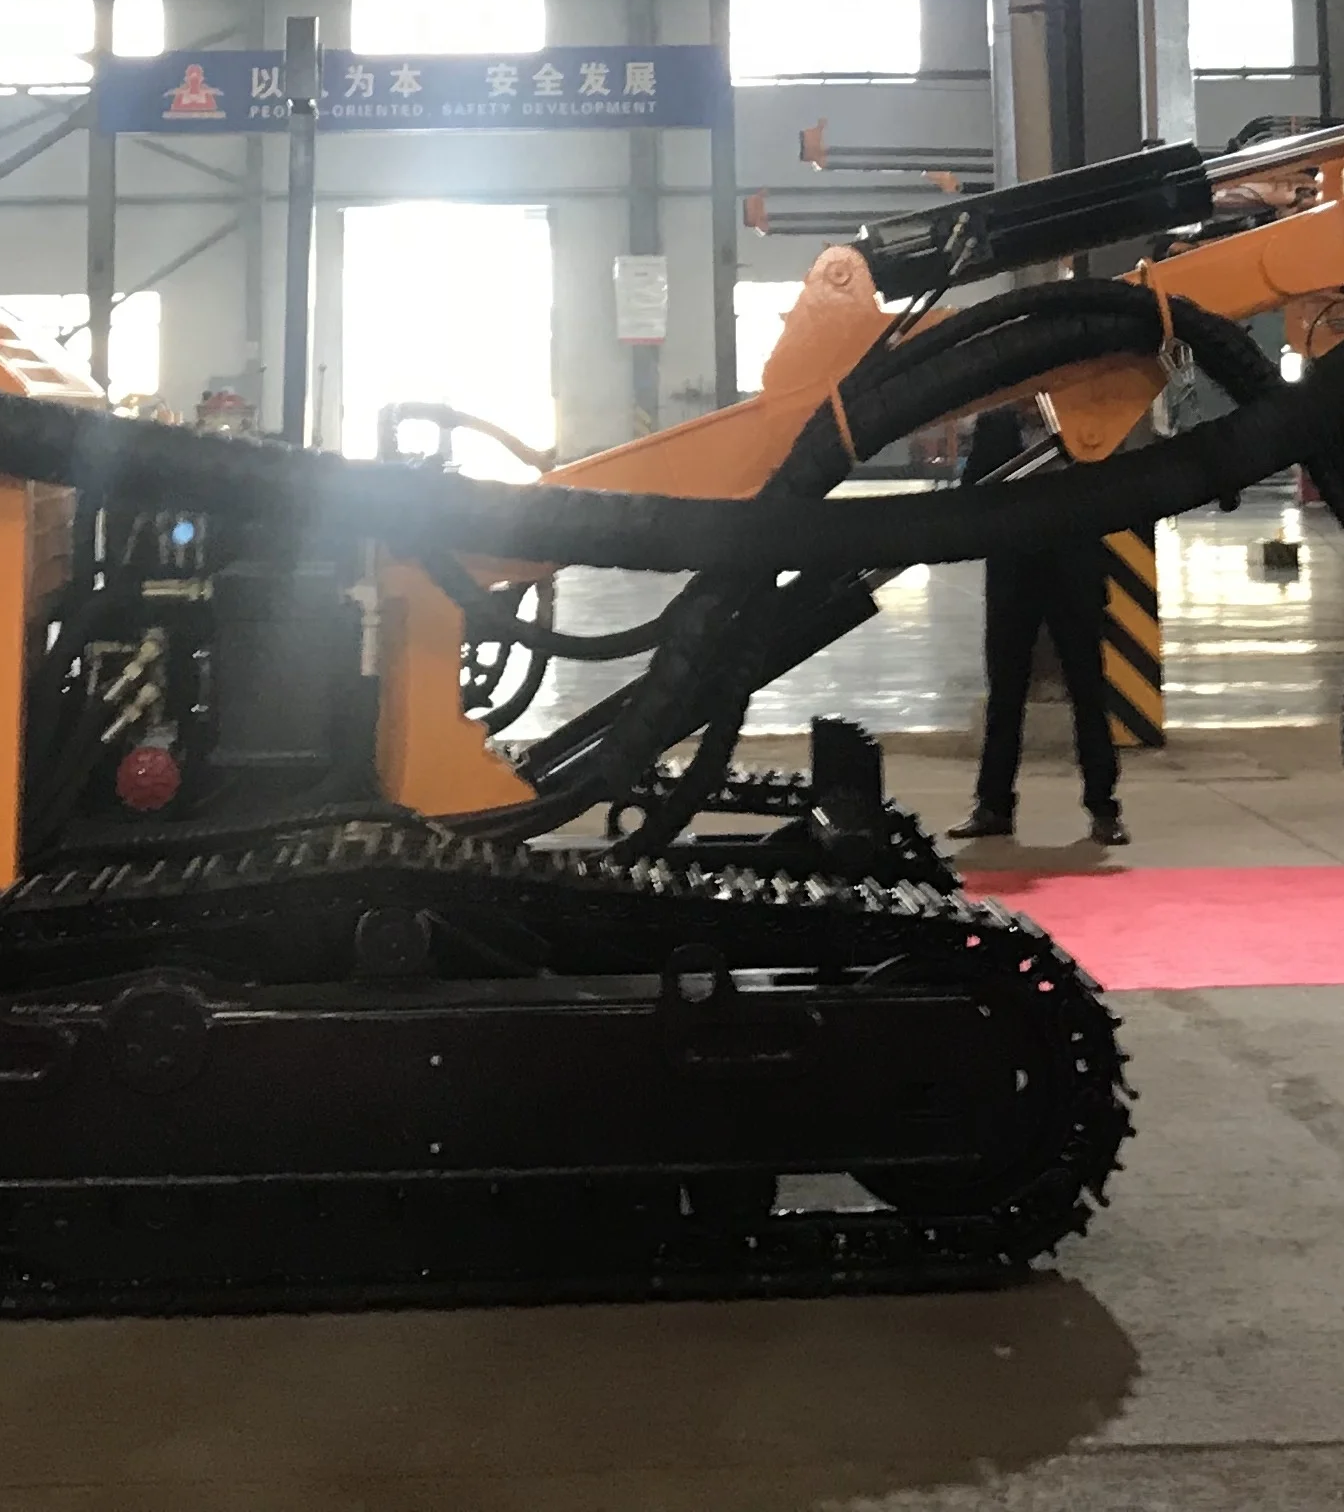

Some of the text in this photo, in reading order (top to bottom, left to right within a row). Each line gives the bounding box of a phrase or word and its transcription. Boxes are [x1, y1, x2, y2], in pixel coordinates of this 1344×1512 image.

[251, 62, 657, 99] 以为本 安全发展
[249, 100, 657, 119] PEO-ORIENTED, SAFETY DEVELOPMENT
